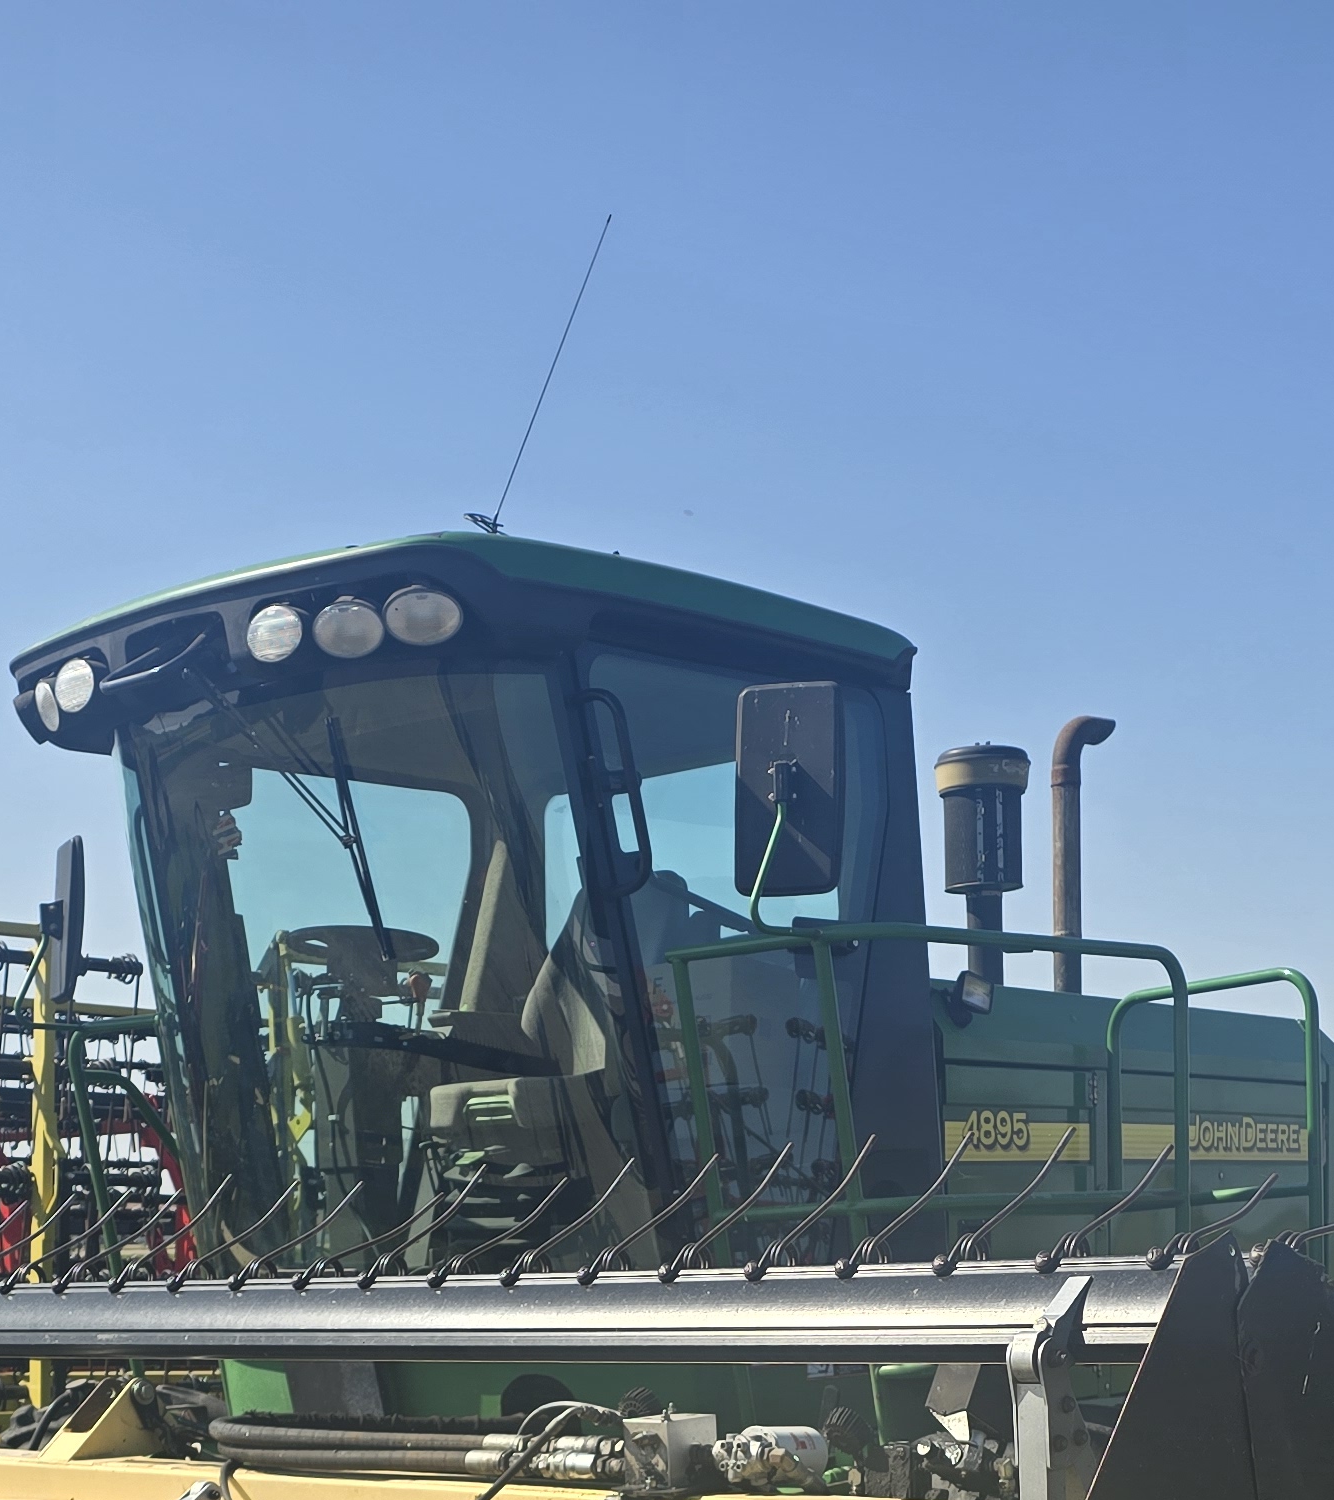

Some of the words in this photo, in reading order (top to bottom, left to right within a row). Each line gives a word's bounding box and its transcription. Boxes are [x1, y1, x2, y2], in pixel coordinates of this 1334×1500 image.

[962, 1109, 1030, 1150] 4895
[1189, 1114, 1241, 1153] JOHN
[1241, 1116, 1301, 1154] DEERE
